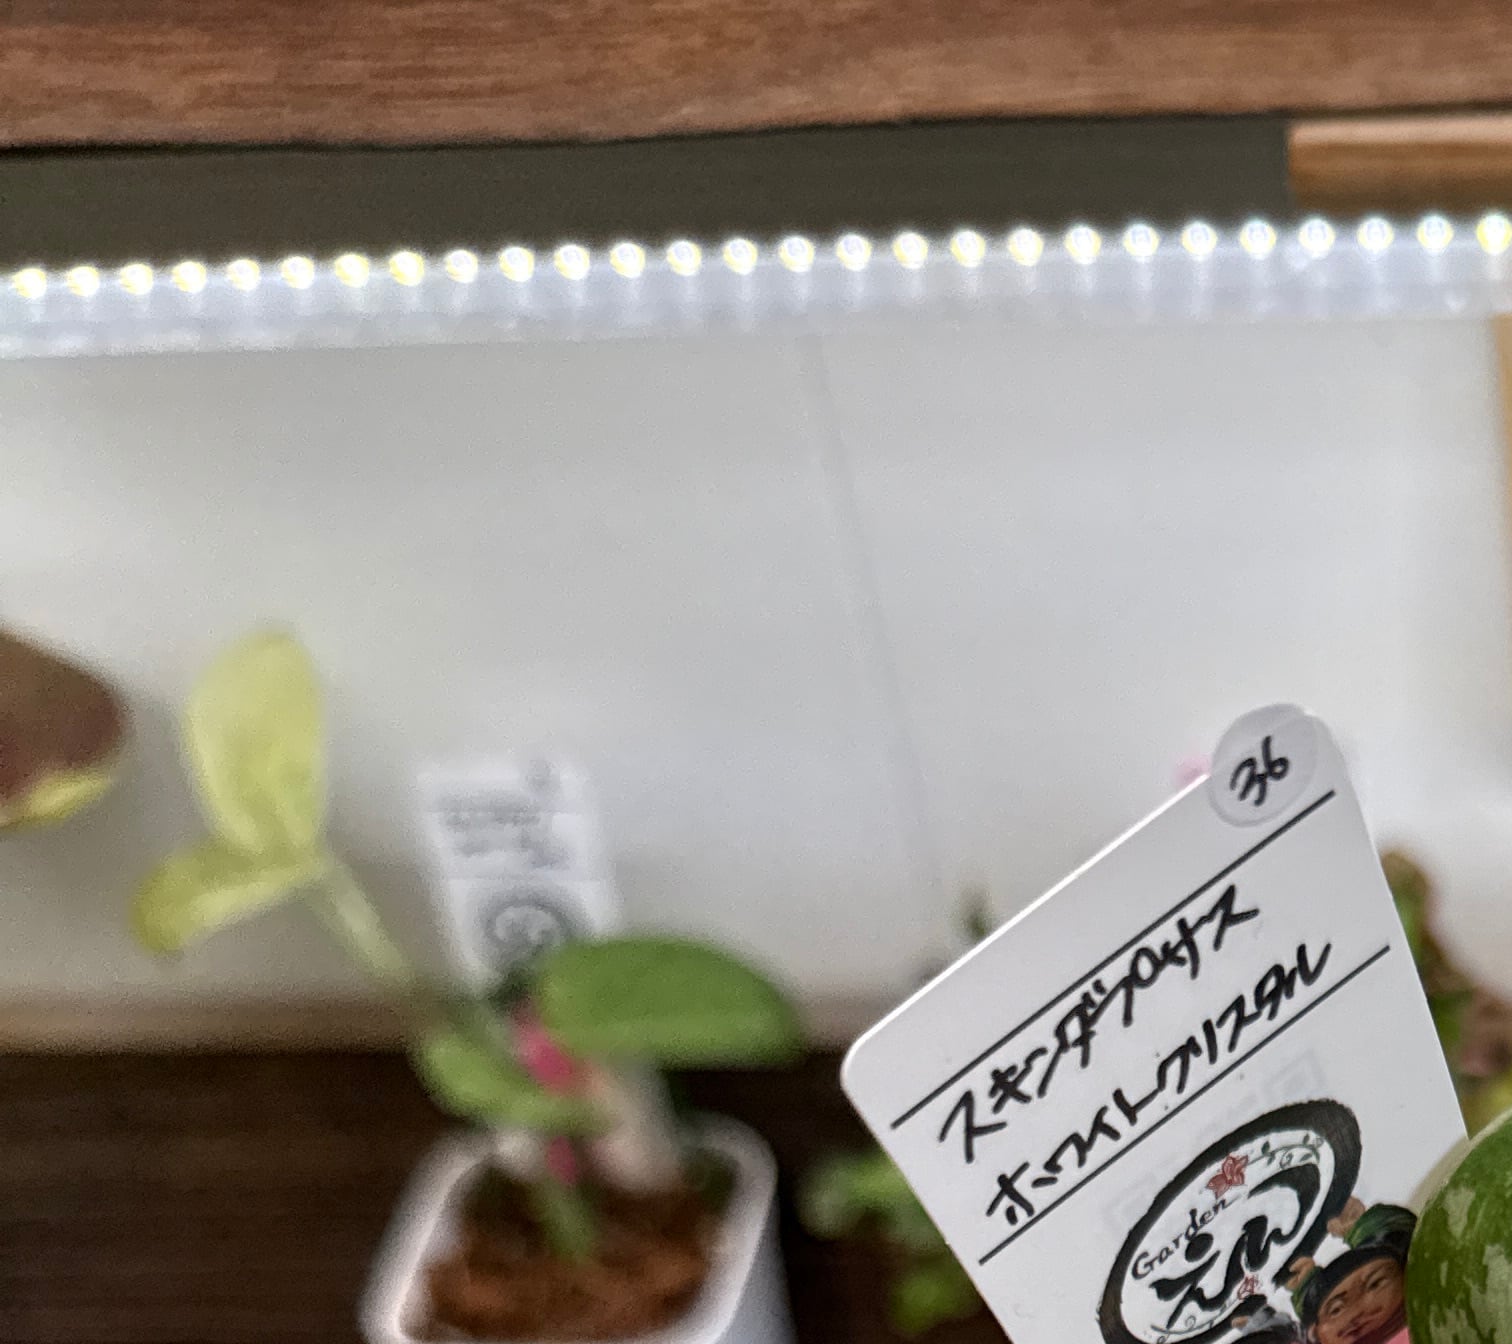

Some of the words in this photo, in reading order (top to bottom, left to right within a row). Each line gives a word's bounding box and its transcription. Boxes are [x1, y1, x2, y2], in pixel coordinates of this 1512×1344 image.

[1229, 735, 1290, 807] 36
[985, 942, 1332, 1225] ホワイトクリスタル
[1131, 1196, 1237, 1280] Garden
